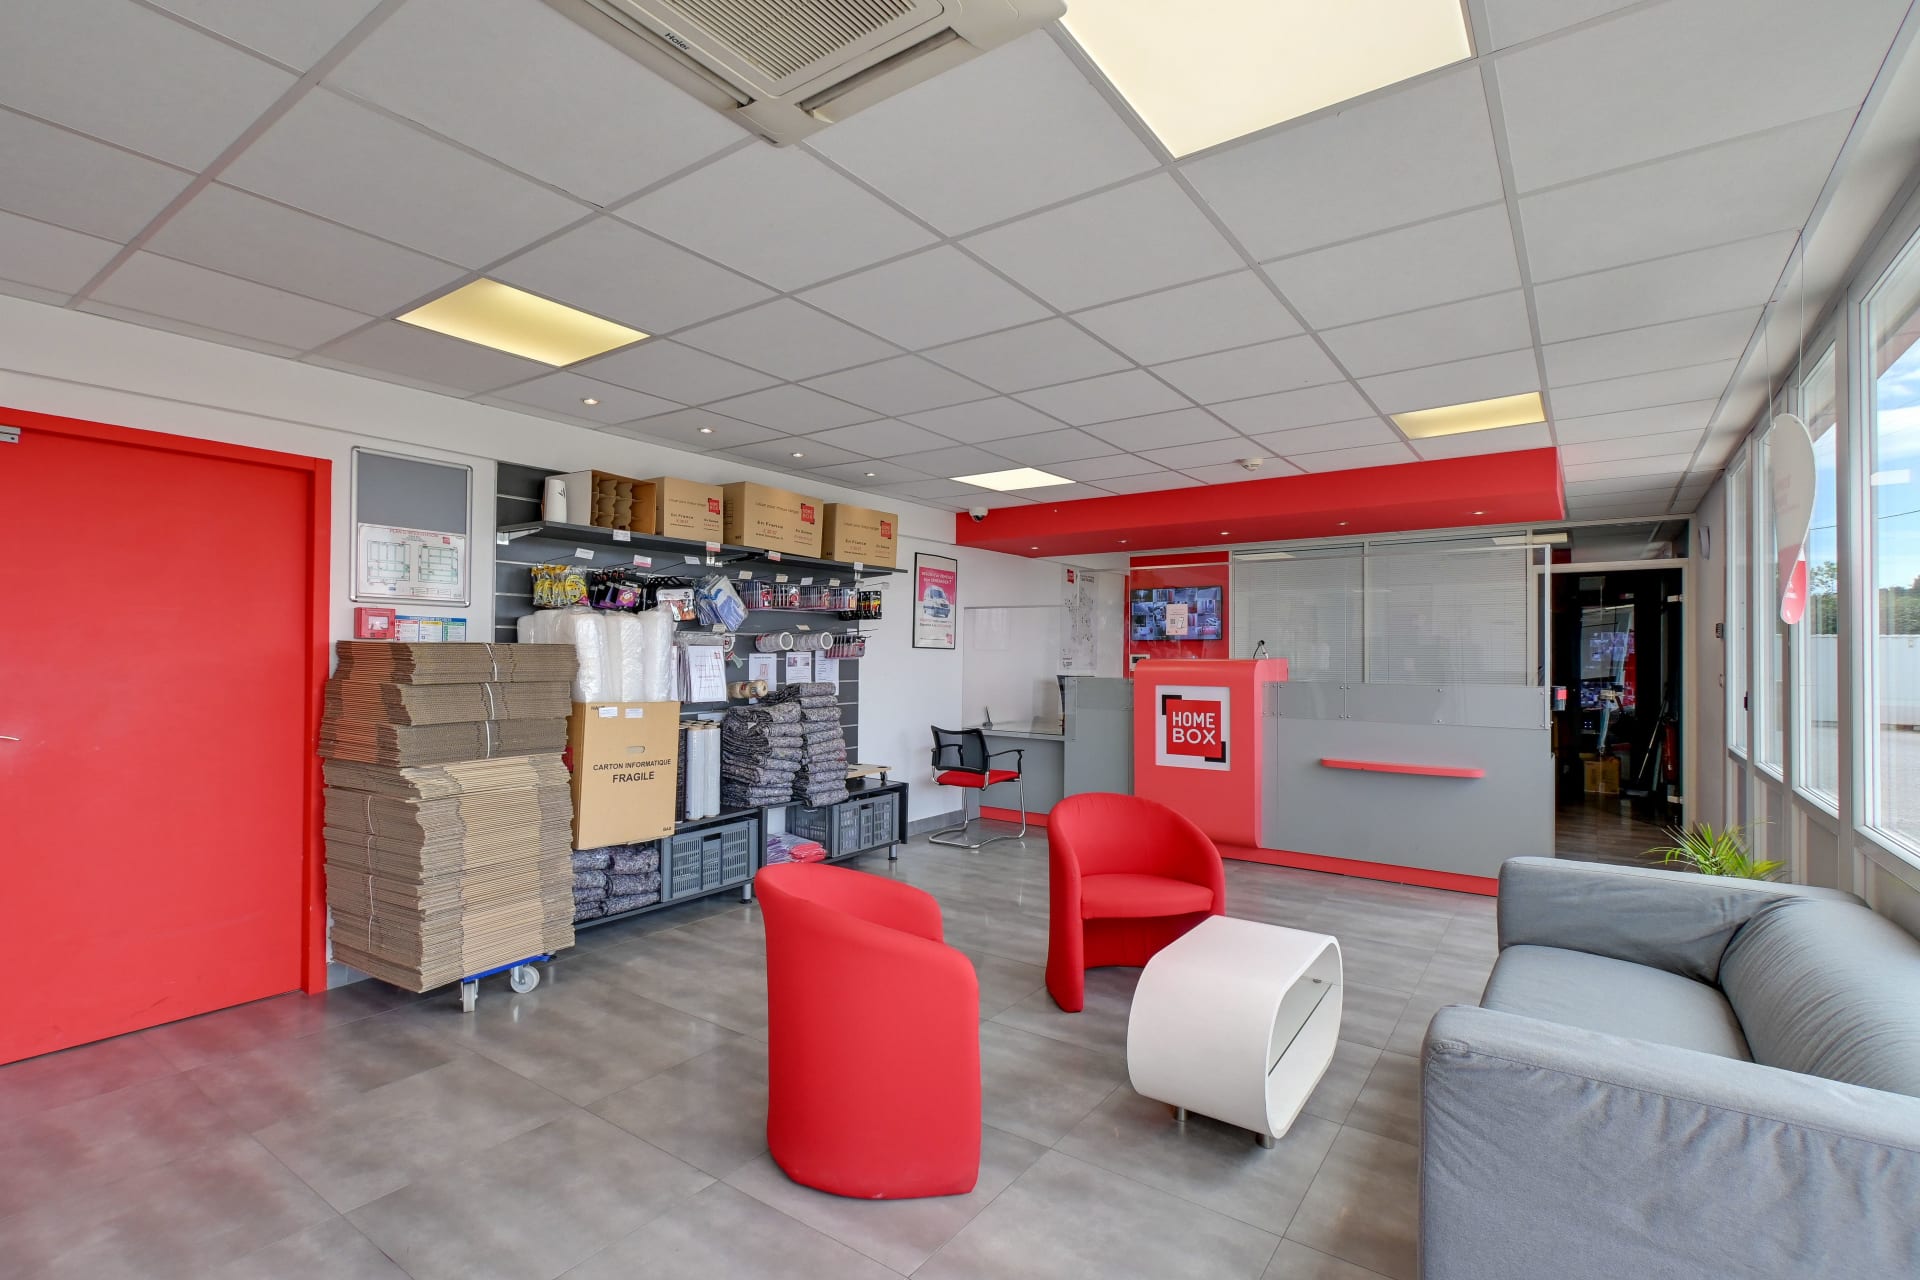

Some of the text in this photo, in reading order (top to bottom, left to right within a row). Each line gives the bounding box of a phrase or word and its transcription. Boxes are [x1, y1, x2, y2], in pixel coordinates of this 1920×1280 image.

[665, 32, 690, 50] Haier
[1172, 711, 1216, 728] HOME
[1172, 727, 1216, 745] BOX
[593, 759, 671, 771] CARTON INFORMATIQUE
[612, 771, 655, 783] FRAGILE
